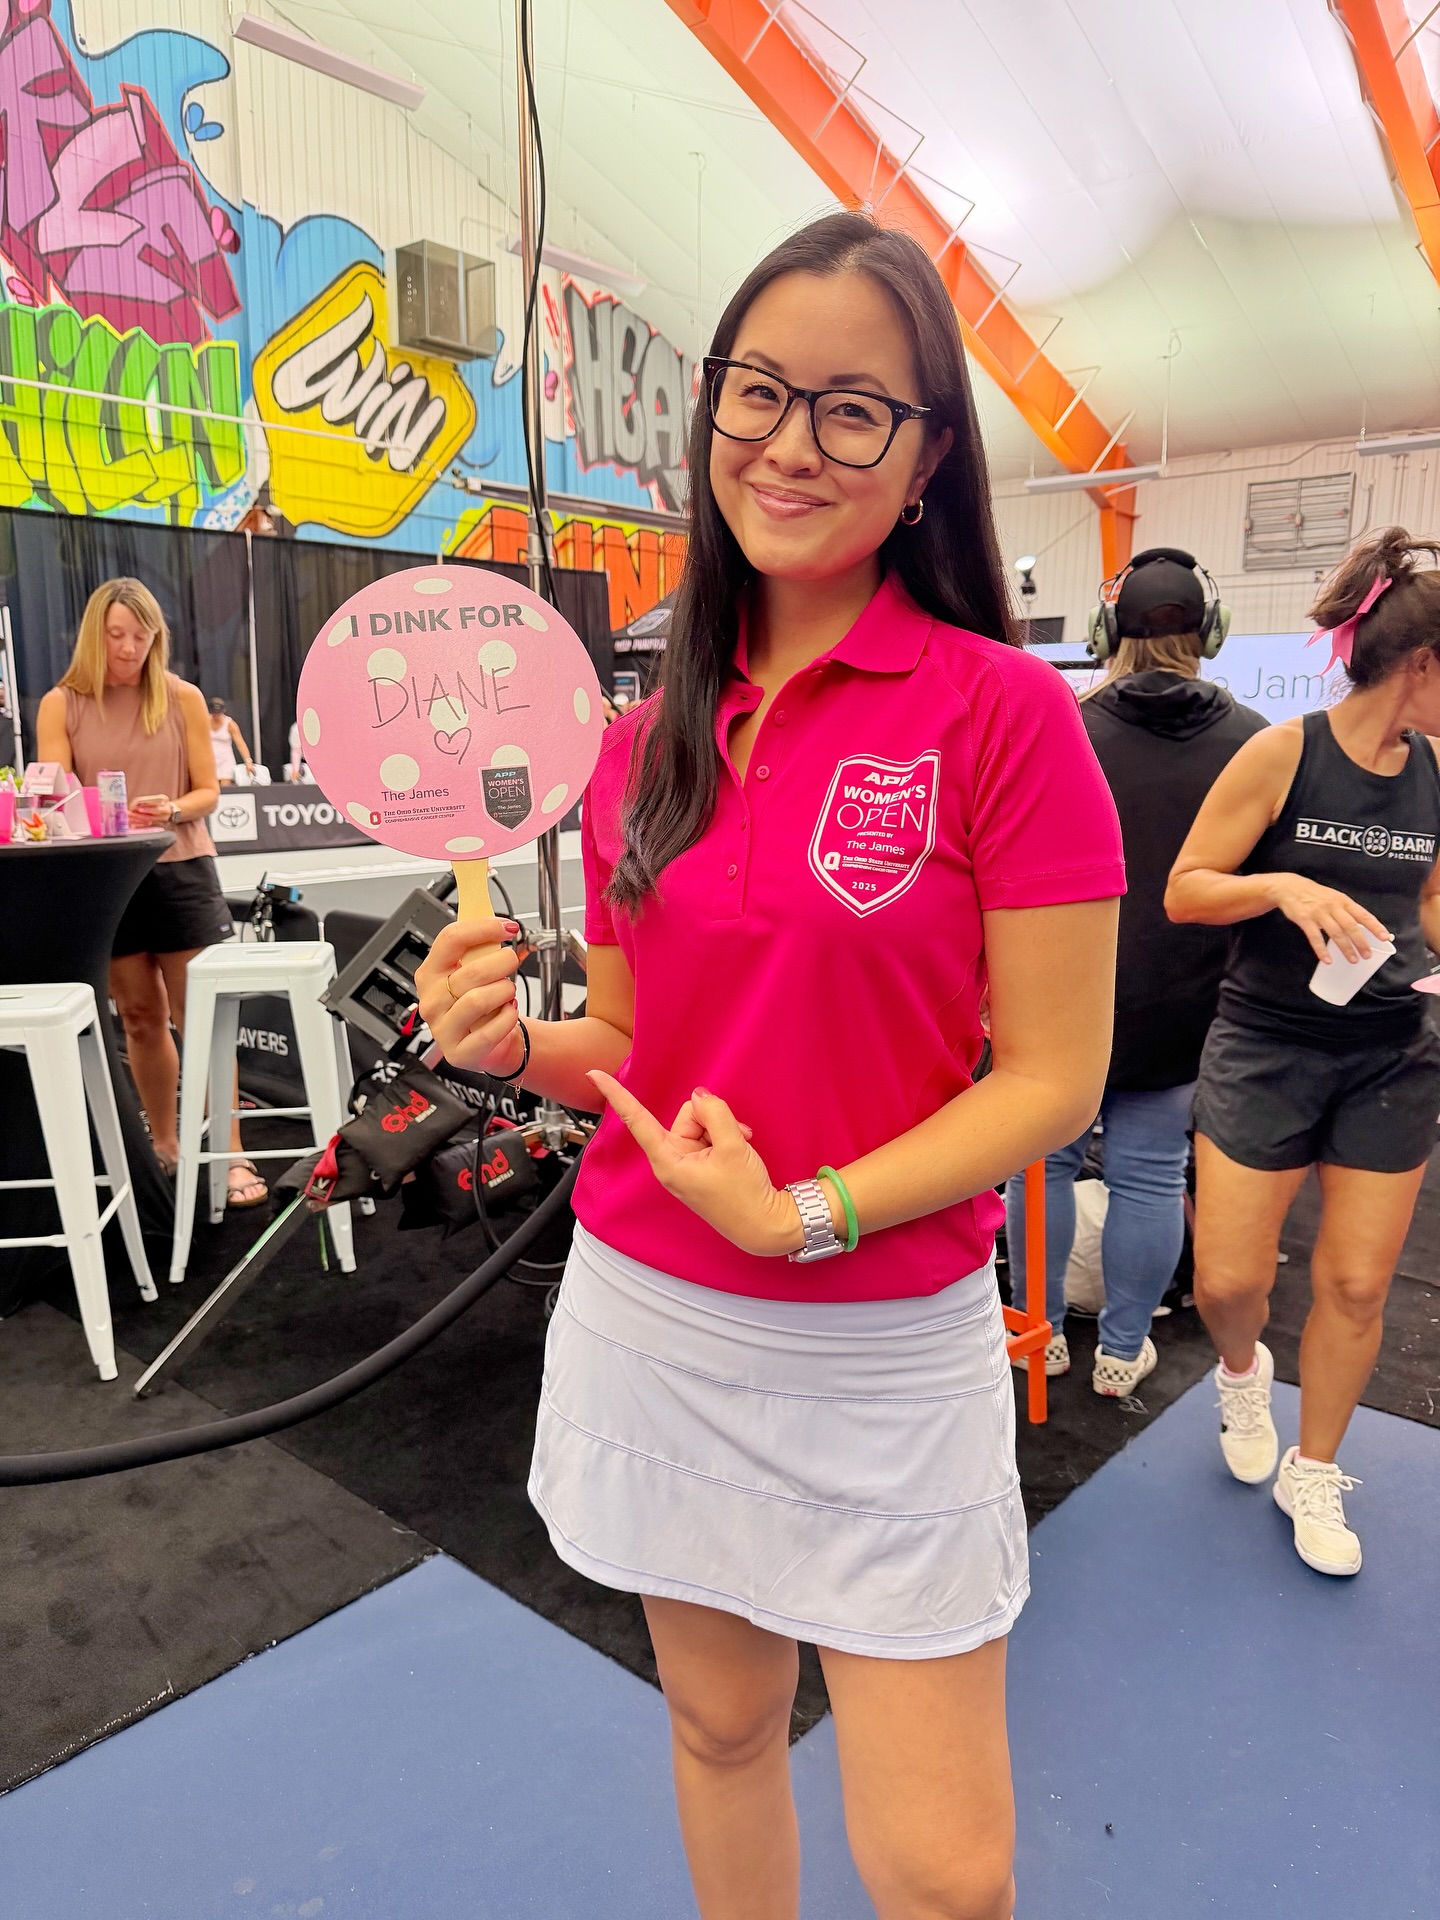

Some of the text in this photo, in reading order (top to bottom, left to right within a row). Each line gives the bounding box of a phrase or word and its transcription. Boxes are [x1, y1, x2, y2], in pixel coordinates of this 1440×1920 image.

[350, 604, 525, 638] I DINK FOR
[1243, 667, 1325, 699] Jam
[368, 665, 531, 729] DIANE
[487, 778, 525, 787] WOMEN'S
[863, 772, 915, 787] APP
[381, 788, 450, 802] The James
[488, 785, 526, 799] OPEN
[844, 785, 926, 805] WOMEN'S
[262, 803, 350, 827] TOYO
[836, 803, 925, 832] OPEN
[846, 840, 905, 855] The James
[1296, 822, 1363, 847] BLACK
[1391, 835, 1436, 854] BARN
[851, 881, 877, 892] 2025
[237, 1026, 289, 1057] AYERS
